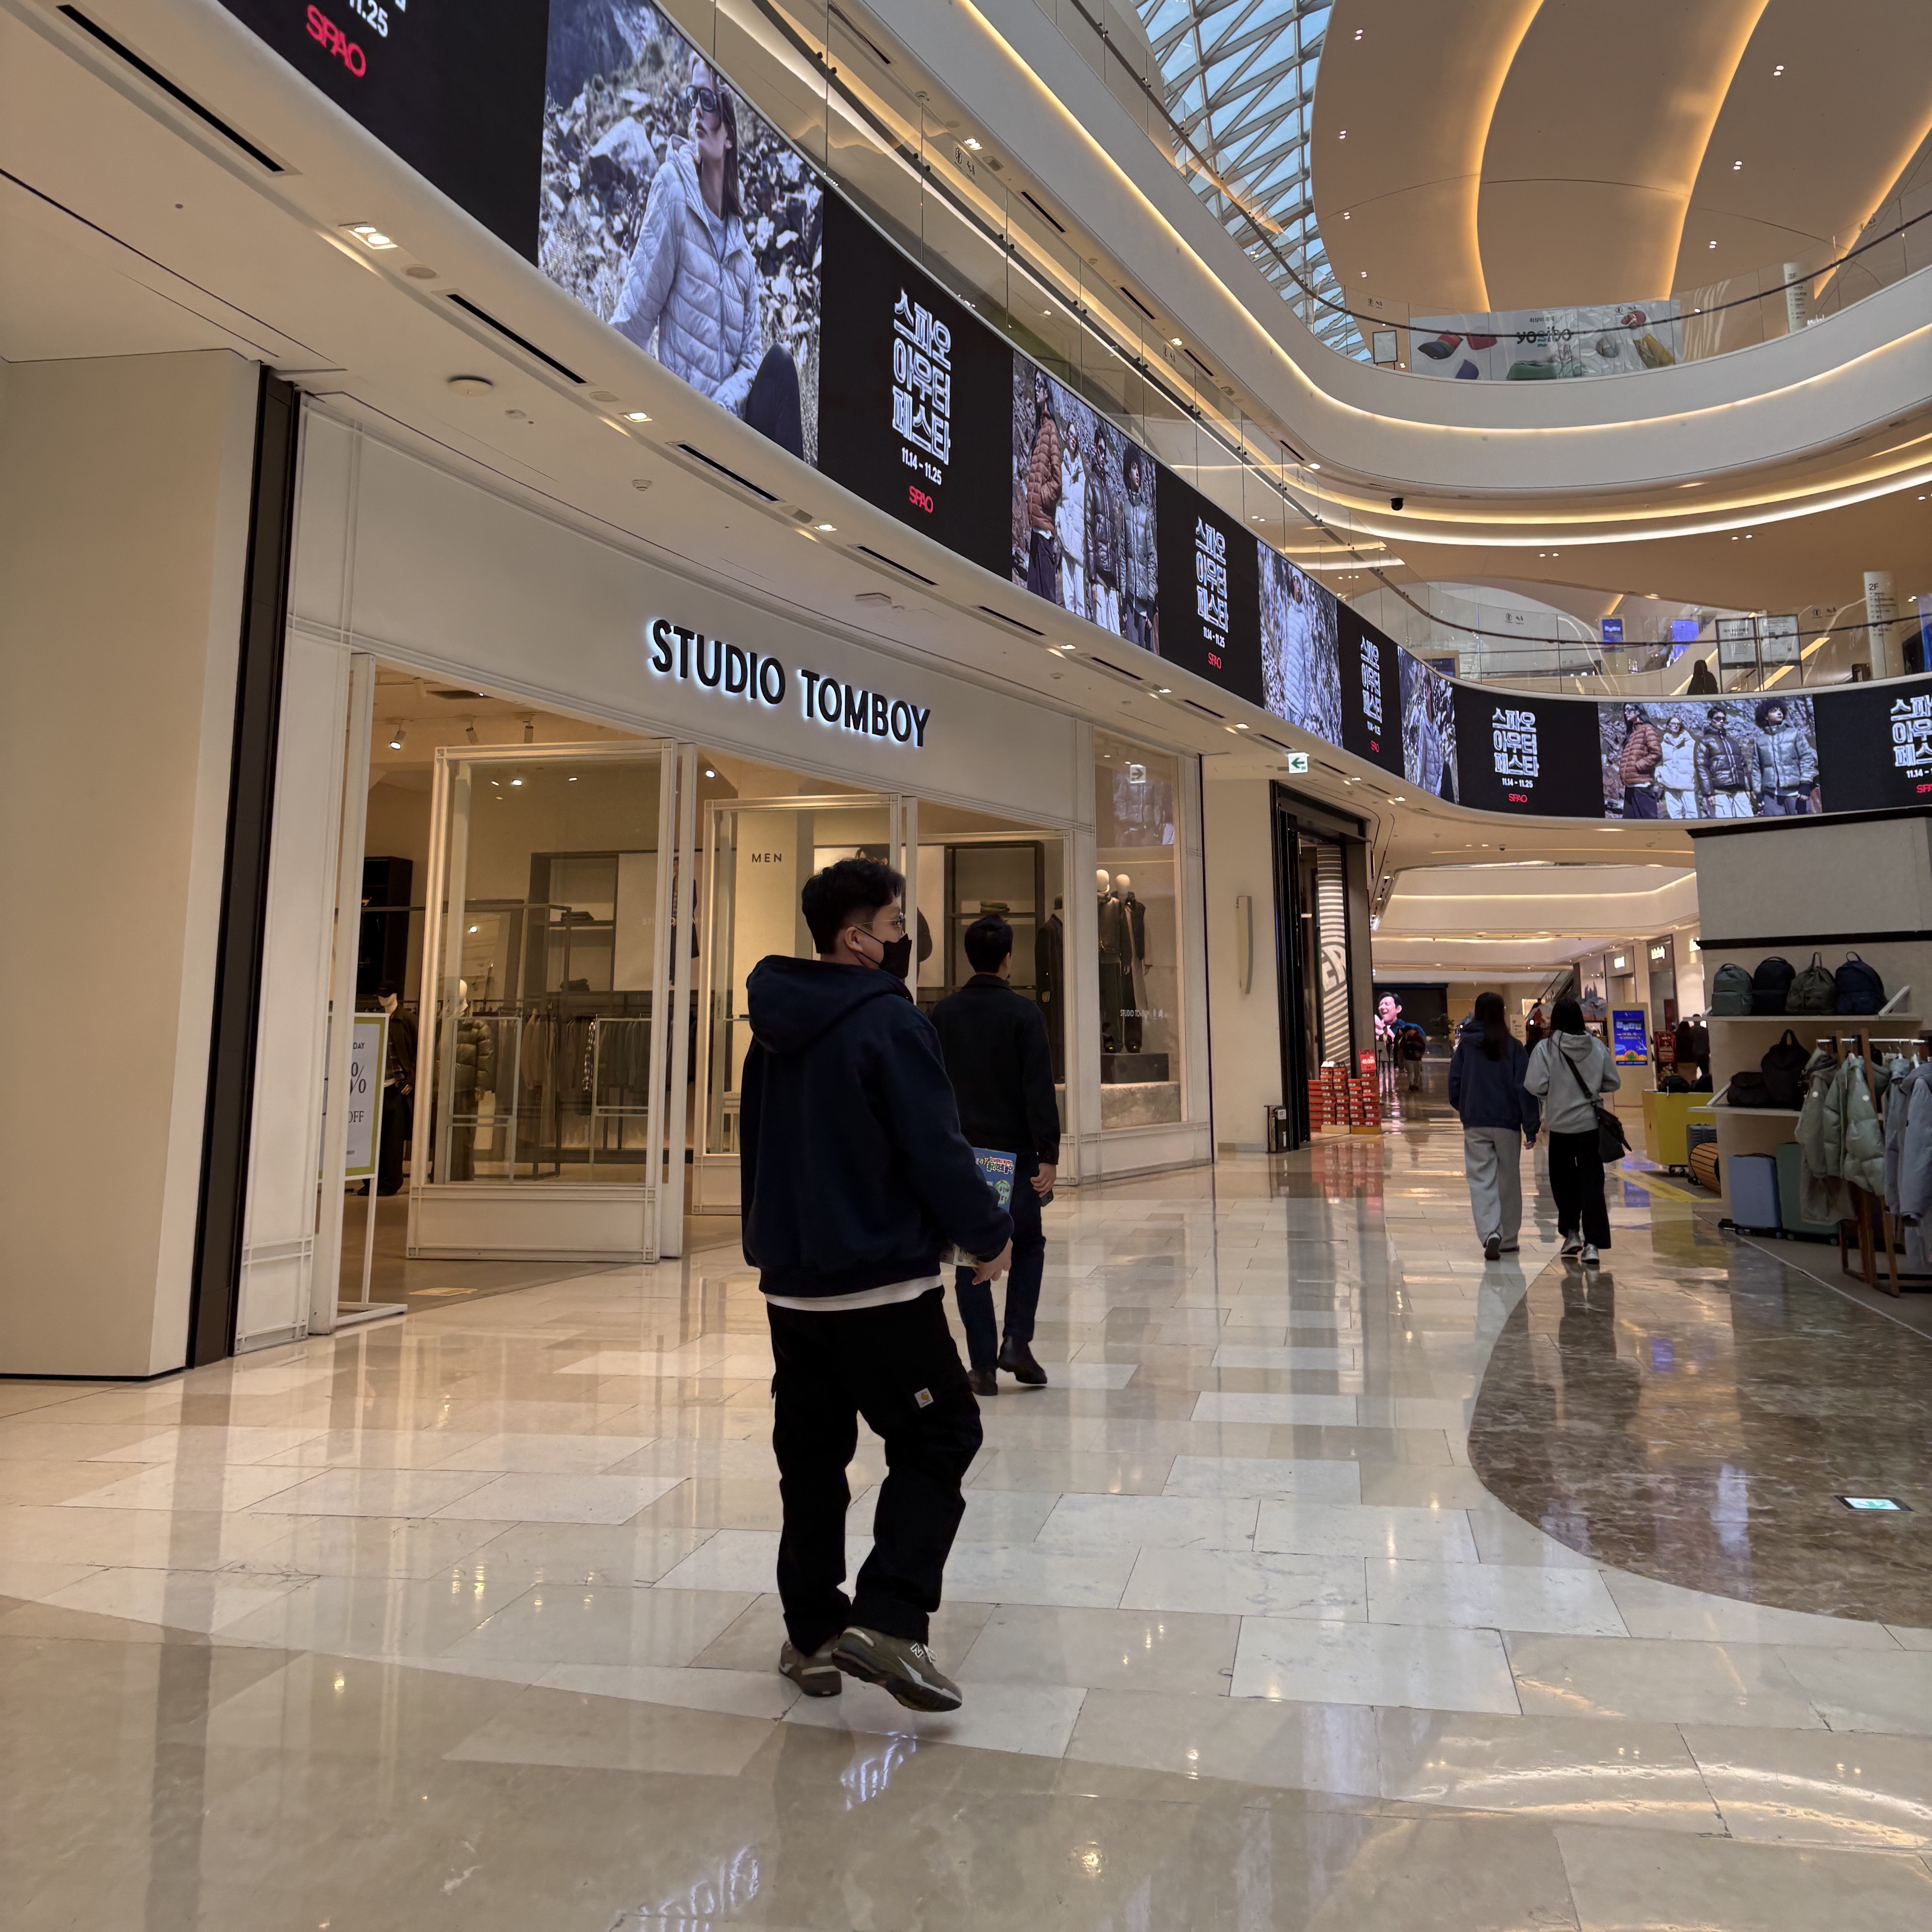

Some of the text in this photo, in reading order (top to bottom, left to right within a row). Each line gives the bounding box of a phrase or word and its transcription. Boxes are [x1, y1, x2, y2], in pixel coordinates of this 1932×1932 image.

[306, 4, 365, 78] SPAO
[894, 287, 951, 371] 스파오
[893, 338, 950, 419] 아우터
[892, 385, 951, 465] 페스타
[902, 447, 918, 470] 11.14
[925, 462, 942, 485] 11.25
[909, 485, 934, 513] SPAO
[1195, 515, 1226, 566] 스파오
[1196, 551, 1227, 600] 아우터
[1196, 584, 1229, 633] 페스타
[649, 619, 931, 747] STUDIO TOMBOY
[1492, 707, 1536, 733] 스파오
[1891, 695, 1932, 721] 스파
[1493, 730, 1537, 755] 아우터
[1494, 752, 1539, 777] 페스타
[1519, 779, 1533, 788] 11.25
[1906, 768, 1923, 778] 11.14
[752, 853, 782, 863] MEN
